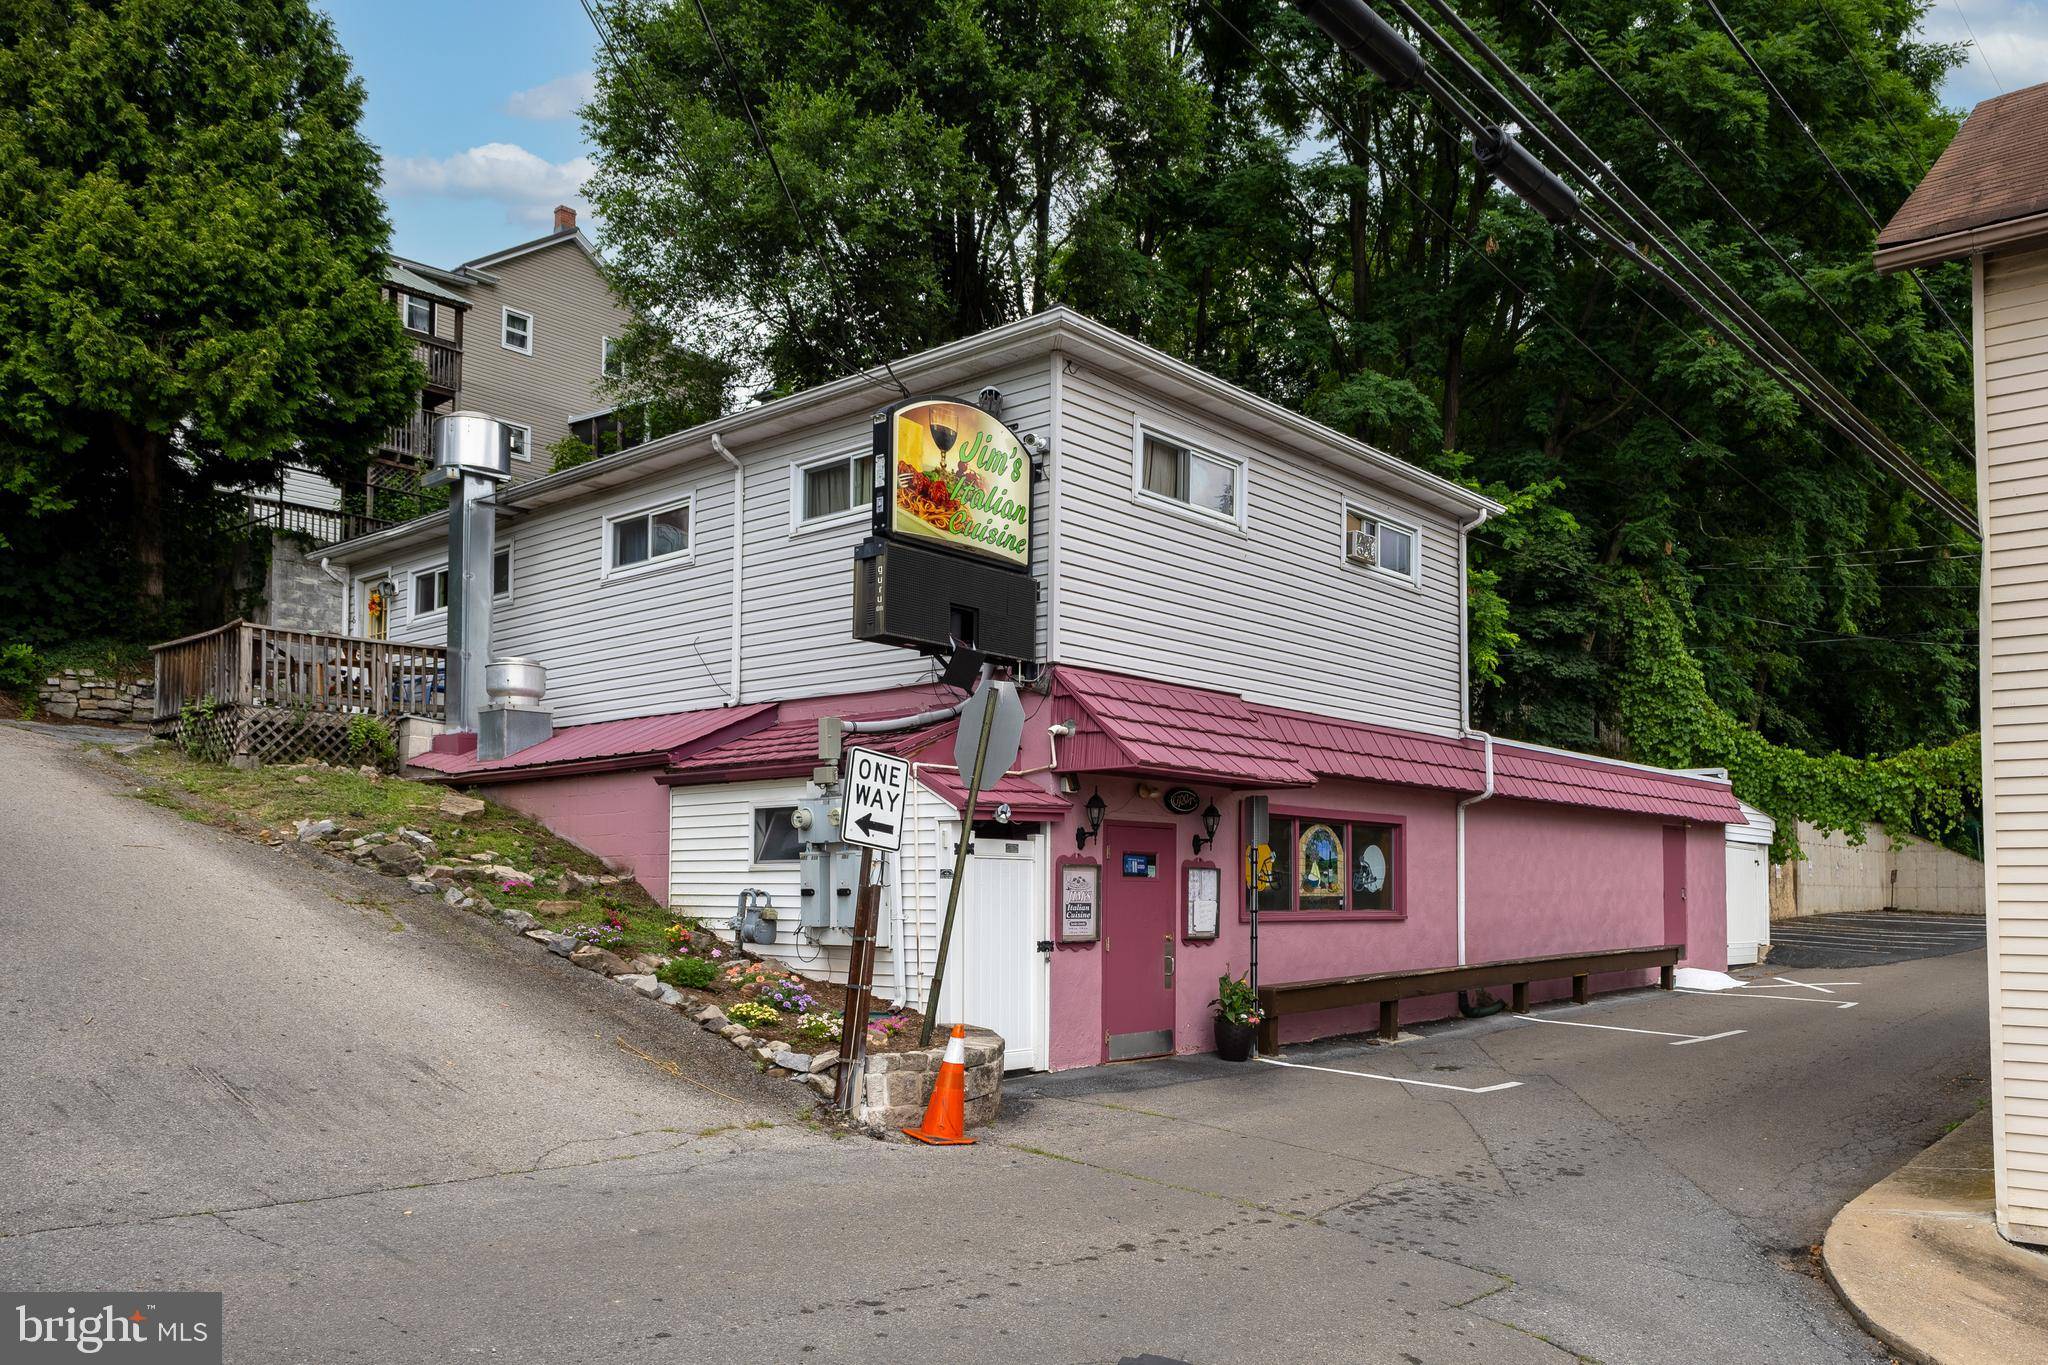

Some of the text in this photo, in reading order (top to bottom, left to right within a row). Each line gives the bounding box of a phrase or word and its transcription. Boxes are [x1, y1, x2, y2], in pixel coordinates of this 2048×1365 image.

[959, 431, 1022, 482] Jim's
[950, 476, 1027, 525] Italian
[949, 511, 1027, 554] Cuisine
[858, 758, 901, 788] ONE
[856, 783, 900, 813] WAY
[1066, 911, 1091, 919] Cuisine
